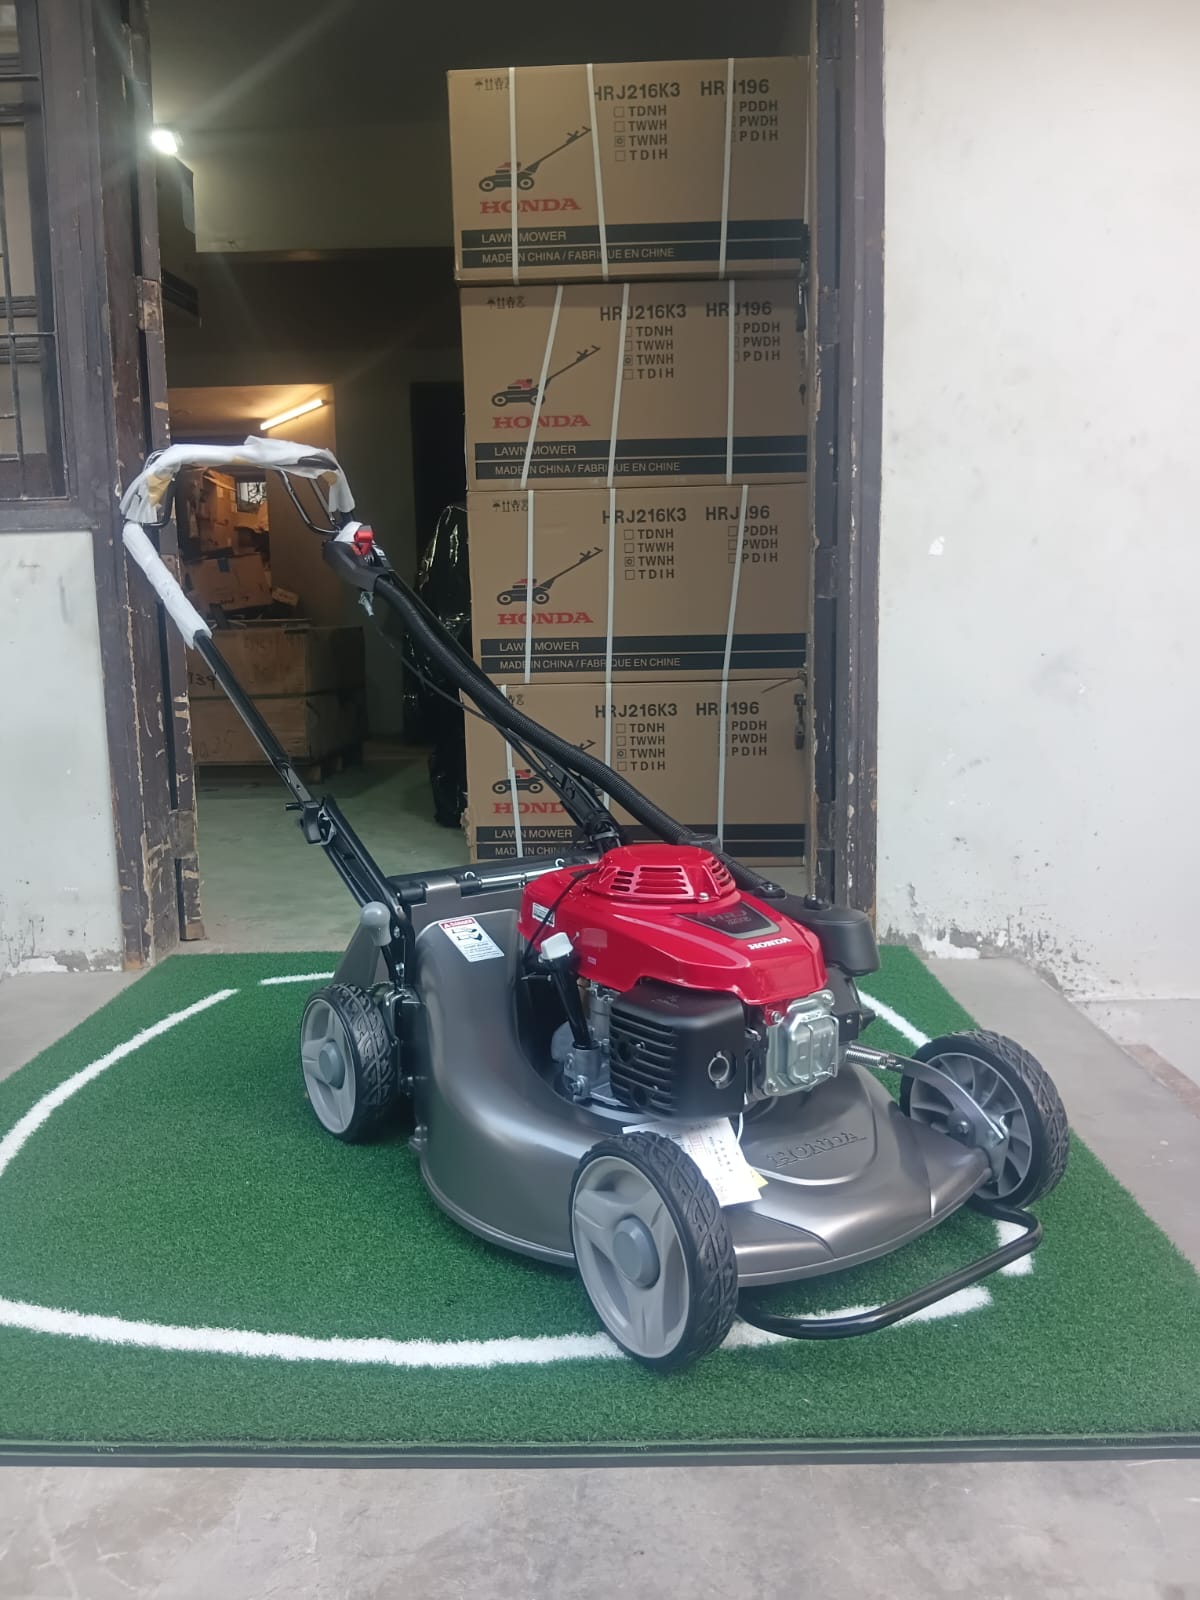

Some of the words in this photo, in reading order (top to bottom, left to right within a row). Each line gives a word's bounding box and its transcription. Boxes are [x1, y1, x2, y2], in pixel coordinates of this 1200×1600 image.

[628, 105, 667, 117] TDNH
[739, 100, 778, 113] PDDH
[628, 120, 667, 132] TWWH
[739, 116, 778, 127] PWDH
[628, 134, 667, 147] TWNH
[739, 130, 779, 142] PDIH
[629, 149, 668, 161] TDIH
[519, 231, 567, 243] MOWER
[482, 254, 513, 264] MADE
[529, 250, 560, 262] CHINA
[568, 248, 622, 260] FABRIUE
[624, 249, 639, 259] EN
[641, 248, 675, 258] CHINE
[600, 304, 687, 322] HRJ216K3
[635, 325, 673, 337] TDNH
[743, 322, 781, 334] PDDH
[636, 340, 673, 351] TWWH
[743, 336, 781, 347] PWDH
[636, 354, 674, 365] TWNH
[743, 350, 781, 362] PDIH
[637, 368, 674, 380] TDIH
[494, 447, 528, 457] LAWN
[530, 445, 577, 455] MOWER
[539, 464, 571, 474] CHINA
[577, 463, 630, 473] FABRIUE
[632, 463, 646, 472] EN
[648, 462, 681, 472] CHINE
[637, 528, 674, 540] TDNH
[743, 525, 778, 537] PDDH
[638, 542, 674, 553] TWWH
[742, 539, 778, 550] PWDH
[638, 555, 674, 566] TWNH
[742, 552, 778, 563] PDIH
[638, 569, 675, 580] TDIH
[535, 641, 580, 651] MOWER
[531, 660, 541, 669] IN
[543, 659, 574, 669] CHINA
[634, 658, 648, 667] EN
[649, 657, 681, 667] CHINE
[630, 723, 665, 733] TDNH
[731, 721, 768, 731] PDDH
[630, 736, 665, 746] TWWH
[731, 734, 768, 744] PWDH
[630, 748, 665, 758] TWNH
[732, 747, 768, 757] PDIH
[631, 761, 666, 771] TDIH
[528, 829, 573, 838] MOWER
[495, 847, 517, 856] MAD
[525, 847, 535, 856] IN
[747, 937, 793, 950] HONDA
[767, 1132, 867, 1168] HONDA
